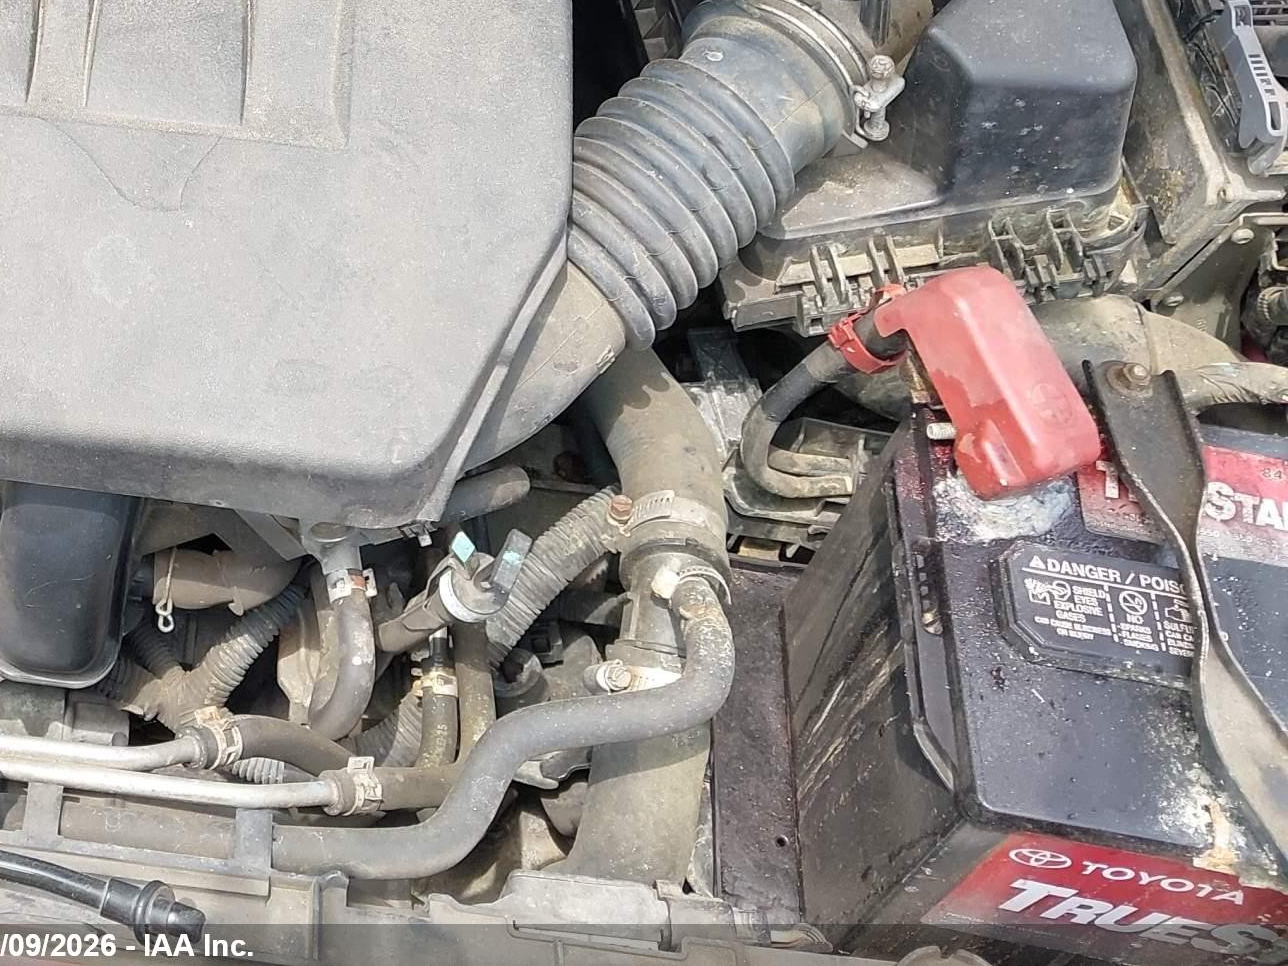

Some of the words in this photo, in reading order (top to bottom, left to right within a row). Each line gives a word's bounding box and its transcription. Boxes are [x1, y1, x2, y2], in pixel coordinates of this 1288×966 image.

[1047, 558, 1121, 584] DANGER
[1072, 586, 1106, 599] SHIELD
[1074, 595, 1098, 607] EYES
[1053, 600, 1104, 617] EXPLOSIVE
[1055, 611, 1087, 623] GASES
[1126, 614, 1144, 625] NO
[1082, 860, 1245, 906] TOYOTA
